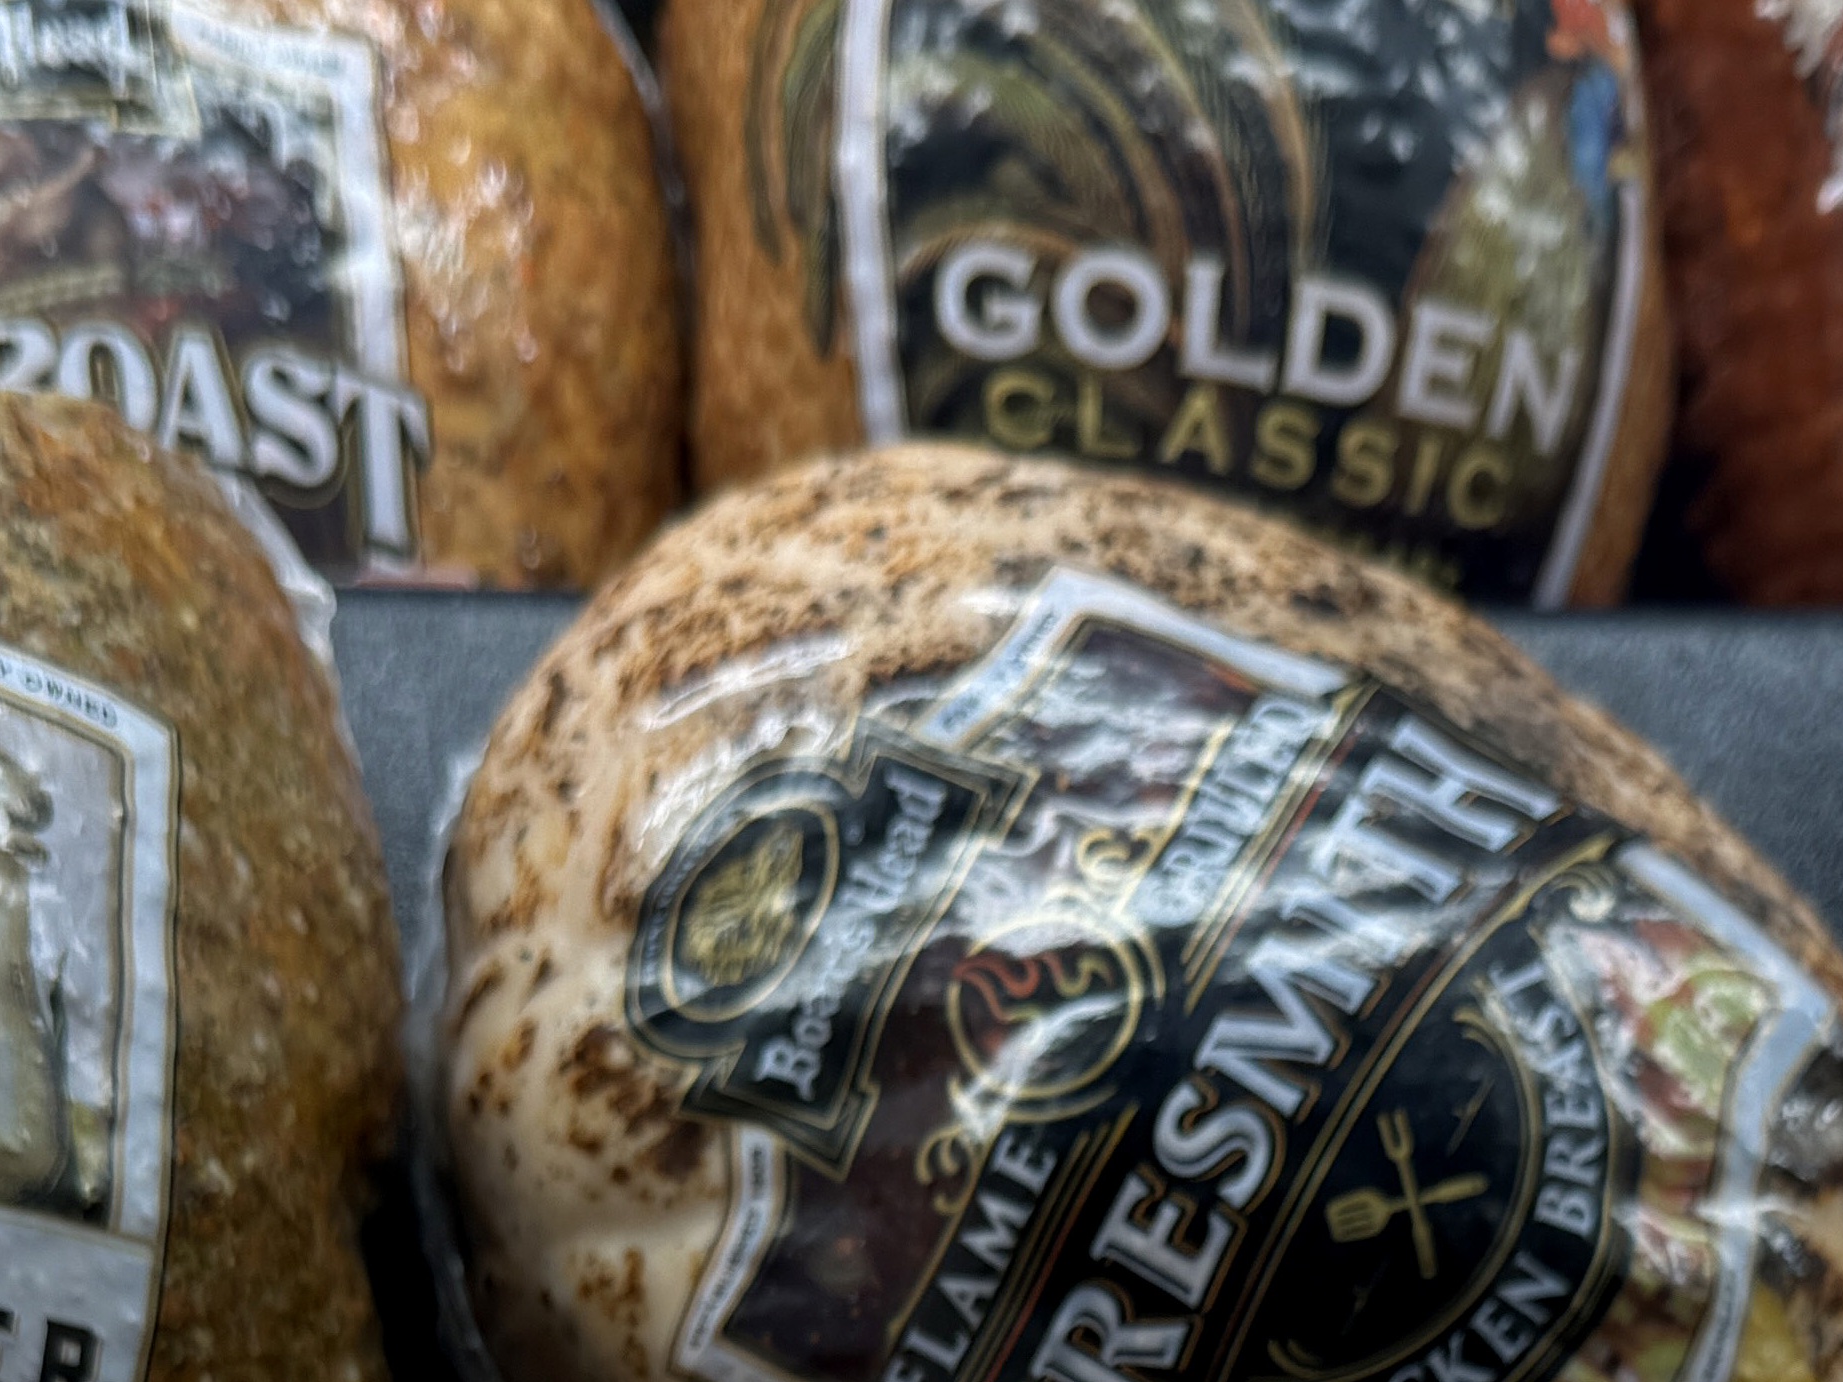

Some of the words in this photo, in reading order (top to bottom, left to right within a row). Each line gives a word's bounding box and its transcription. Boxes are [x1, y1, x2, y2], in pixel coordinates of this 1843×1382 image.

[935, 241, 1581, 456] GOLDEN
[983, 371, 1517, 529] CLASSIC
[1491, 958, 1608, 1239] BREAST
